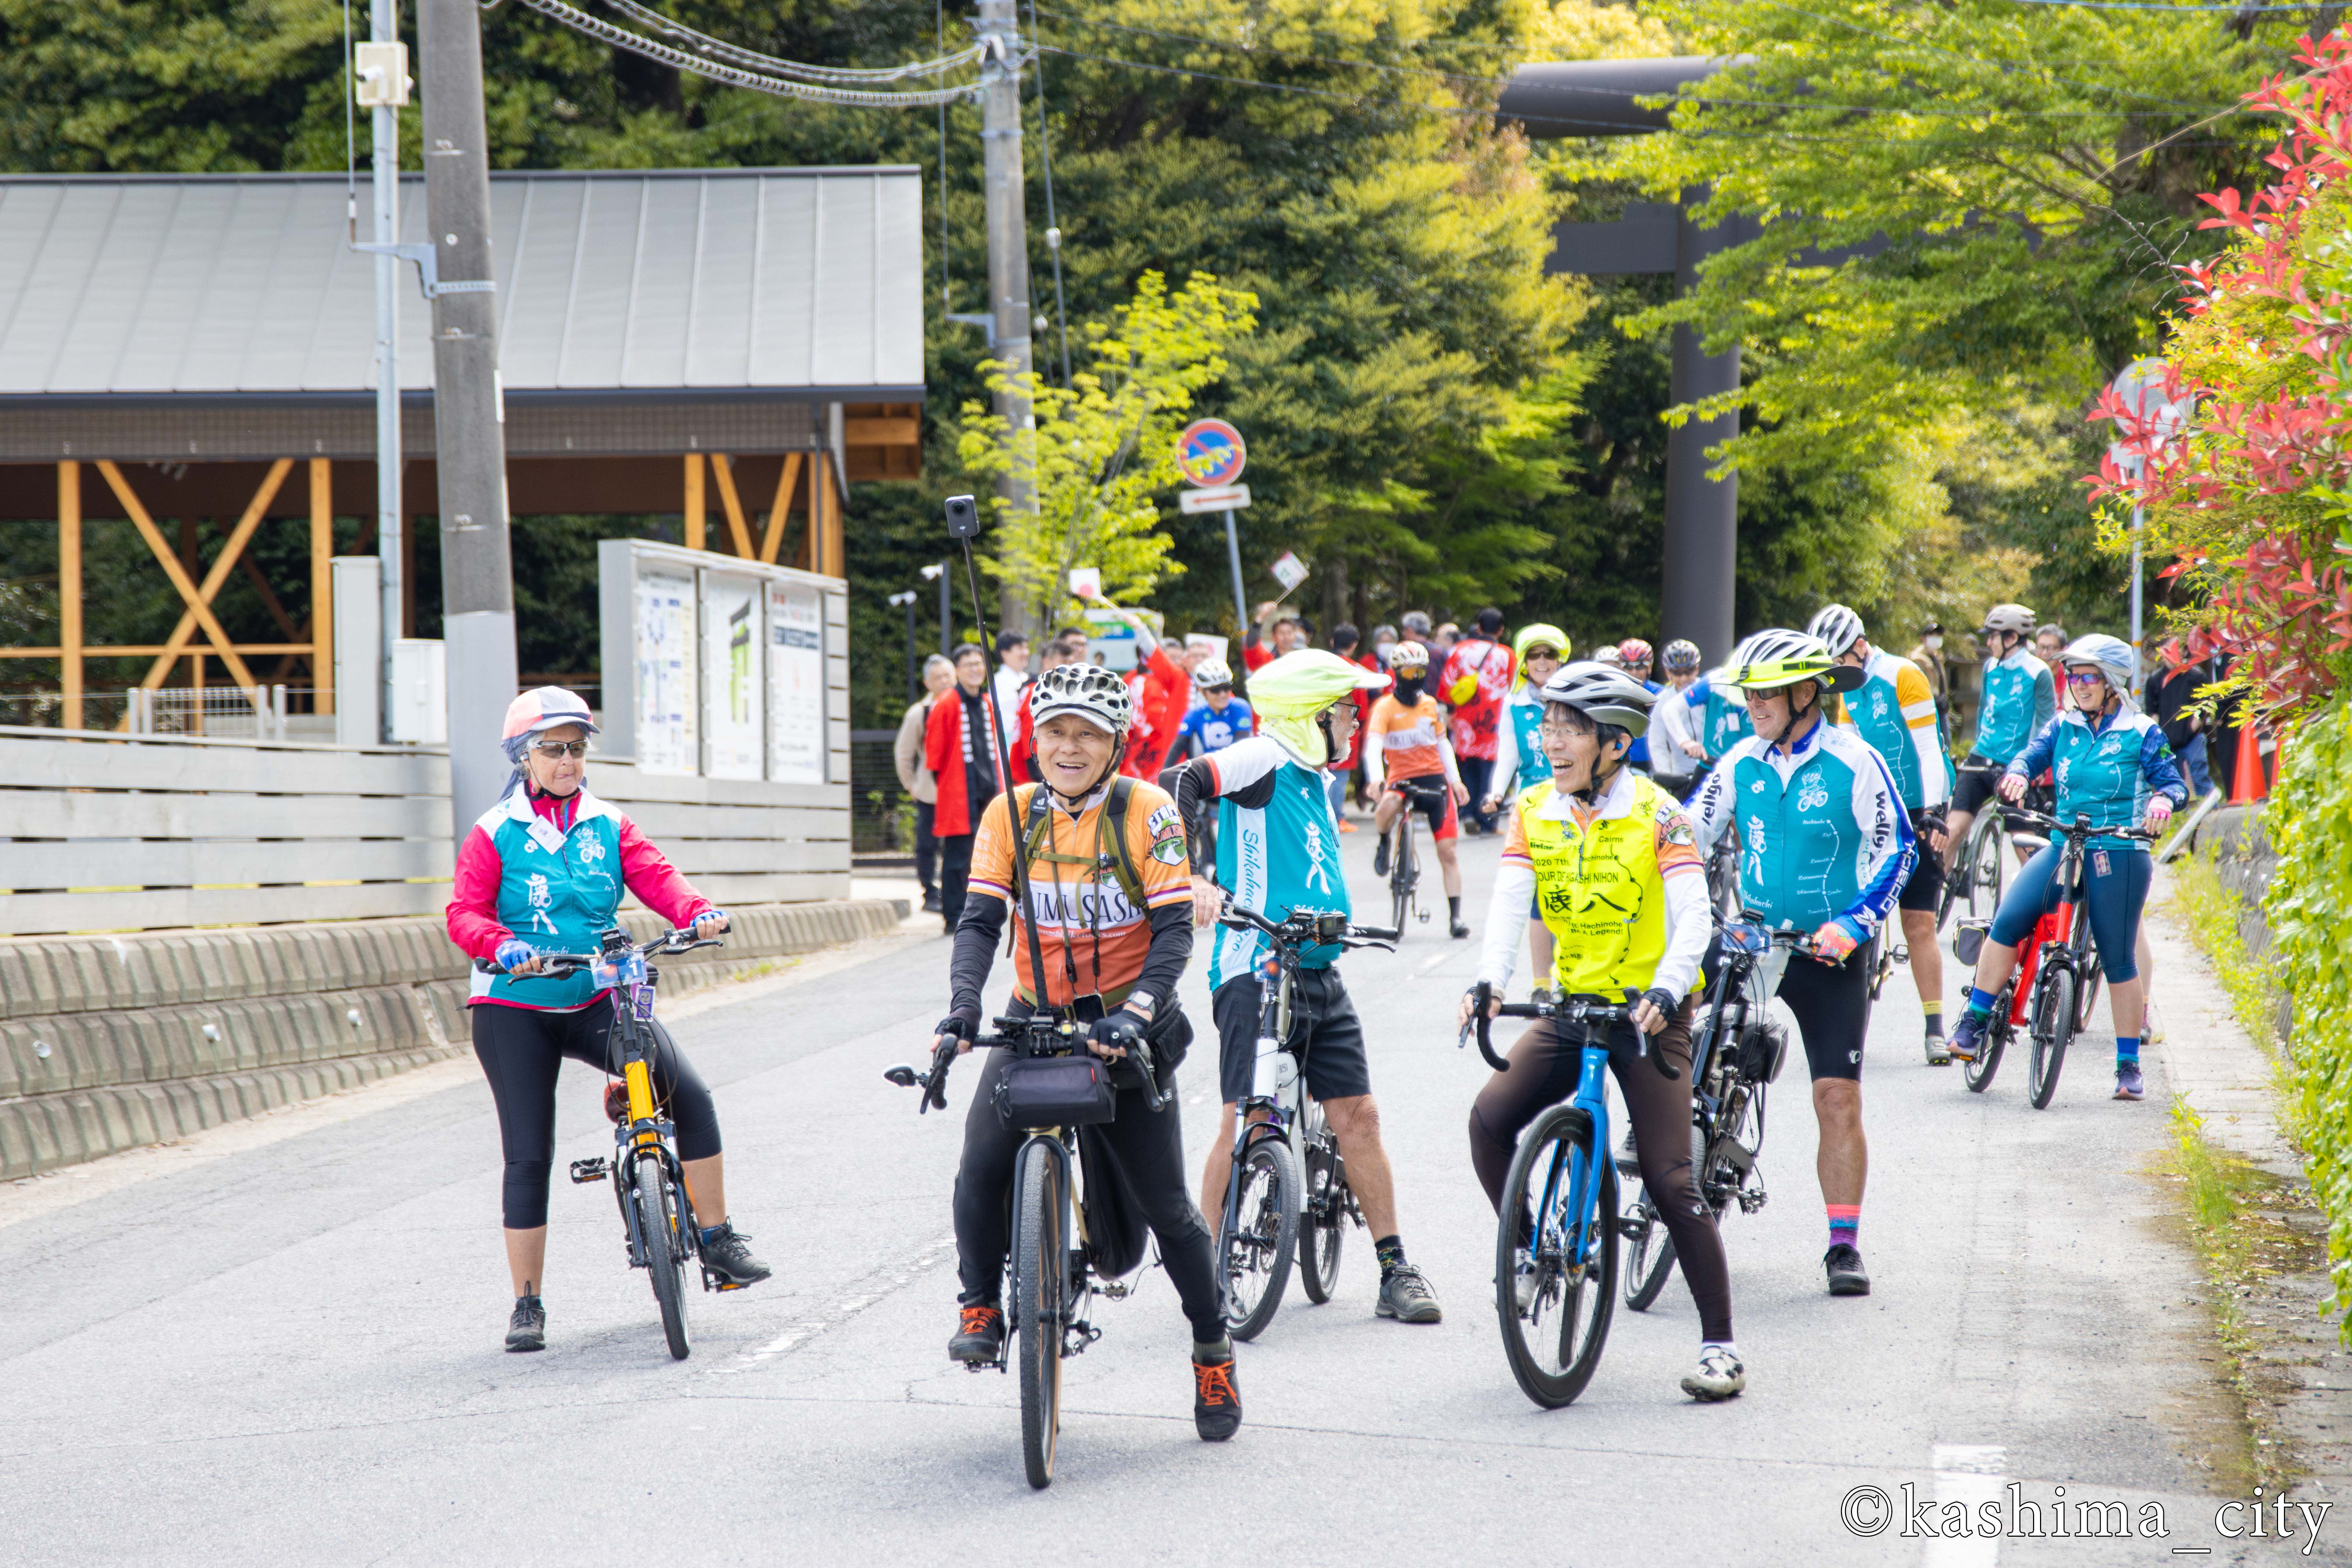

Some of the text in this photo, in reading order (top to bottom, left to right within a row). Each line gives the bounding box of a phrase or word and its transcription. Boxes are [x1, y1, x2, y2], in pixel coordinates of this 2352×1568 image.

[1304, 820, 1331, 895] 鹿八
[1747, 814, 1767, 886] 鹿八
[1243, 829, 1261, 909] Shikahac
[1536, 871, 1556, 881] OUR
[1594, 872, 1618, 884] NIHON
[524, 872, 558, 935] 鹿八
[1543, 884, 1628, 913] 鹿八
[1581, 920, 1622, 930] Hachinohe
[1590, 928, 1623, 936] Legend!
[530, 944, 570, 955] ikahachi
[629, 962, 638, 976] 1
